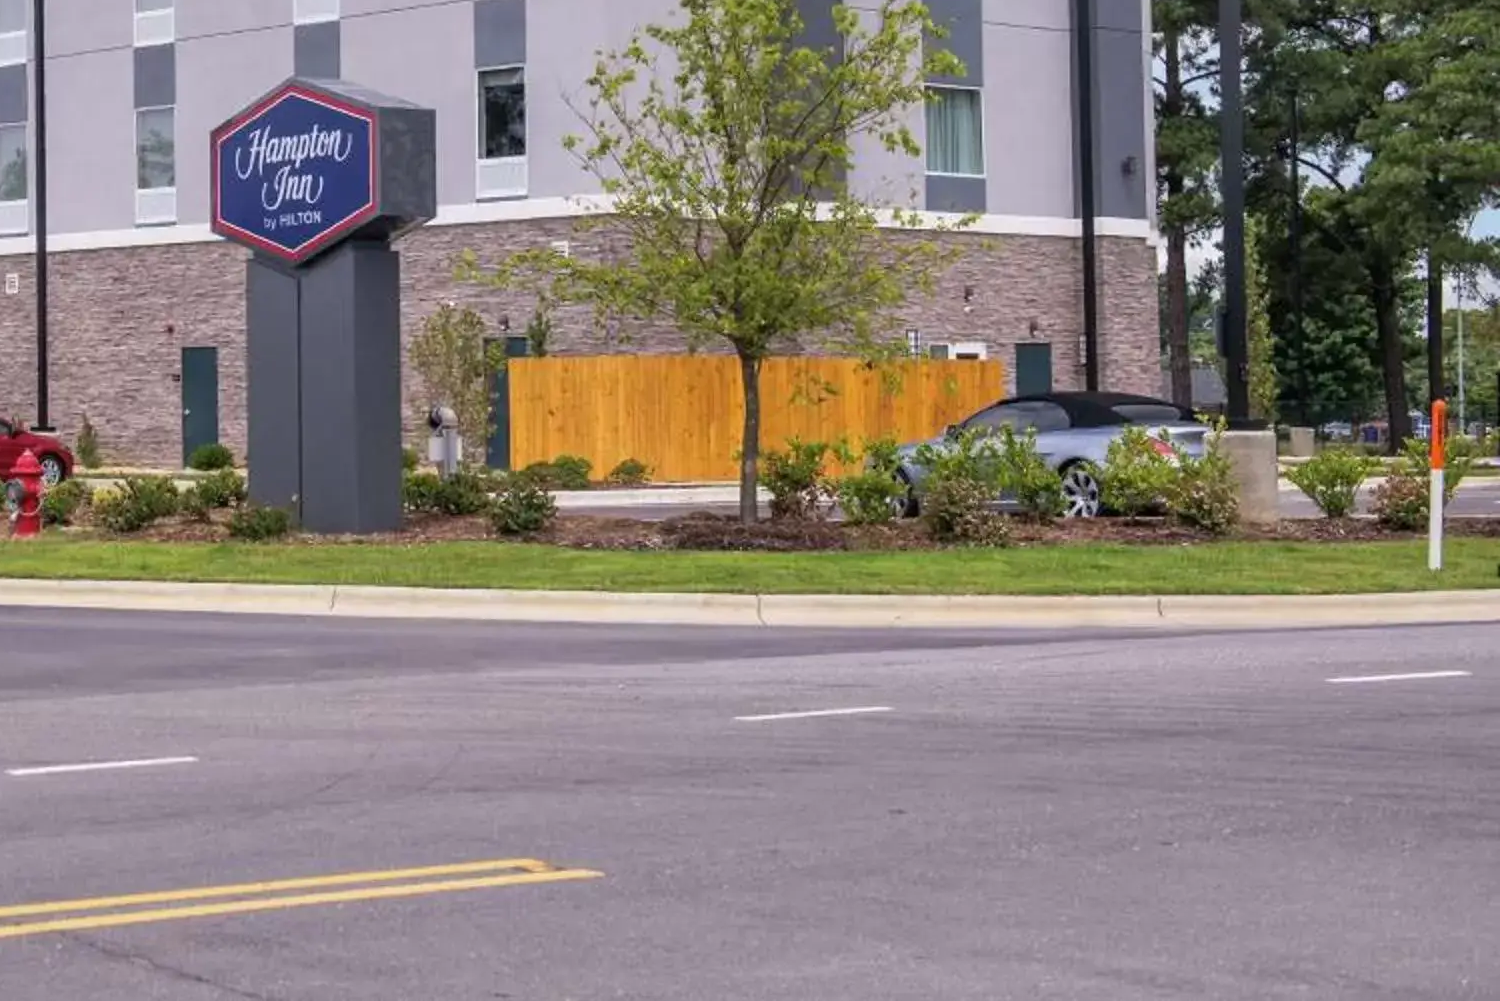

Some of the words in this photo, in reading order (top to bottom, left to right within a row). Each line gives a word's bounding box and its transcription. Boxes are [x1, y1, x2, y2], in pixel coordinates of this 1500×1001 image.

[235, 123, 353, 180] Hampton
[261, 165, 324, 210] Inn
[263, 215, 277, 231] by
[280, 210, 322, 227] HILTON
